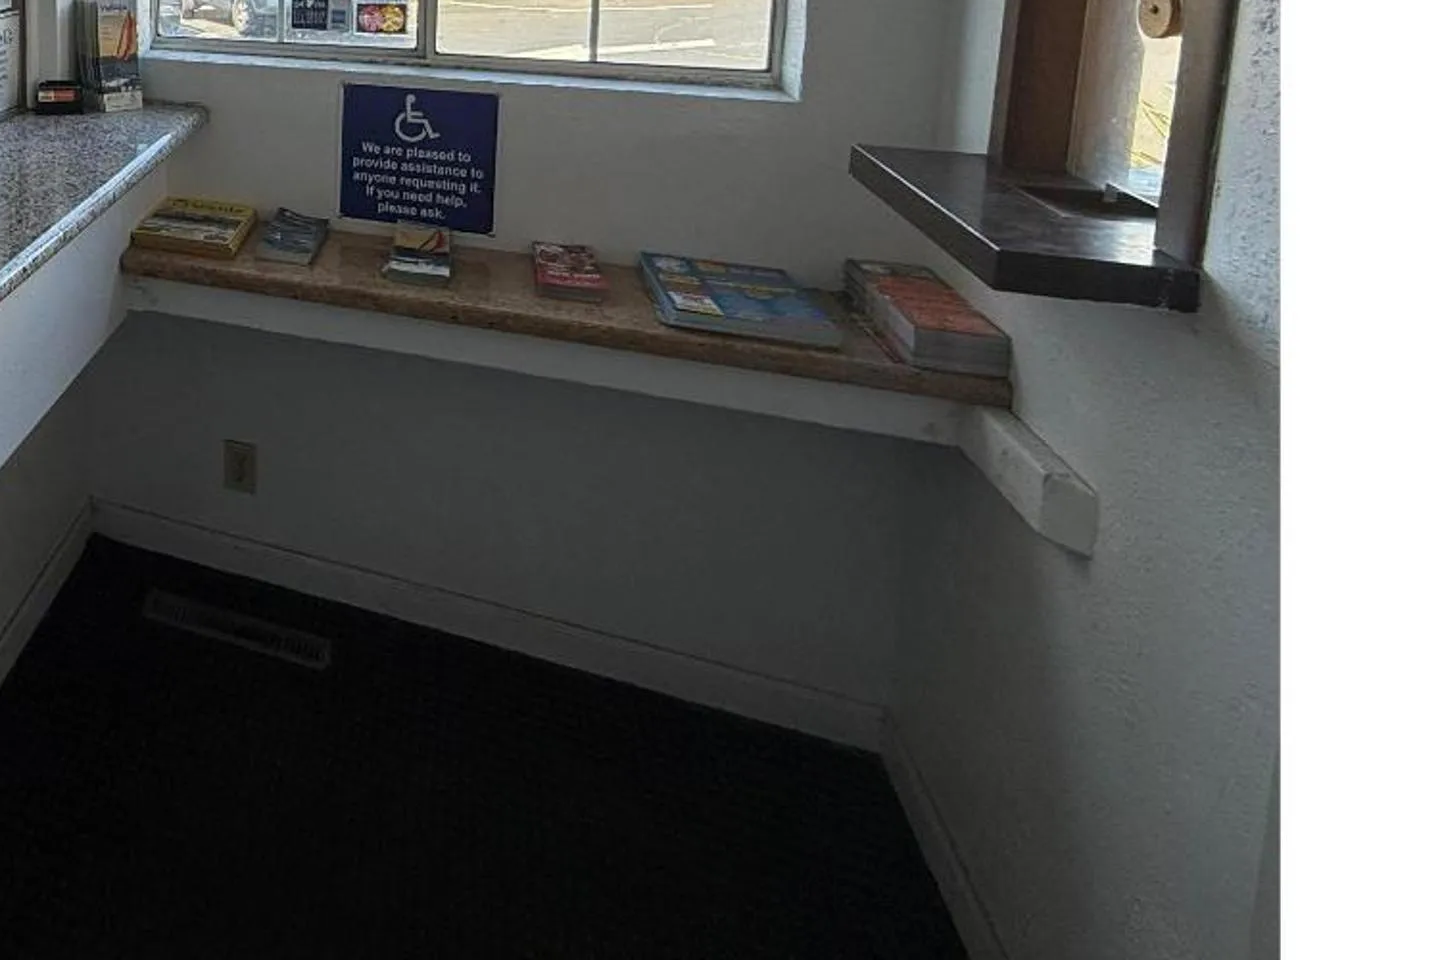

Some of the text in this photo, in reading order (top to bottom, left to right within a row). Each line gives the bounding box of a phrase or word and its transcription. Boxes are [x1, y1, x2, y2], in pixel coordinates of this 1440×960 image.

[362, 141, 471, 163] We are pleased to
[353, 156, 483, 180] provide assistance to
[353, 171, 396, 185] anyone
[400, 176, 466, 195] requesting
[366, 185, 374, 197] If
[376, 188, 400, 200] you
[402, 189, 433, 203] need
[377, 201, 418, 216] please
